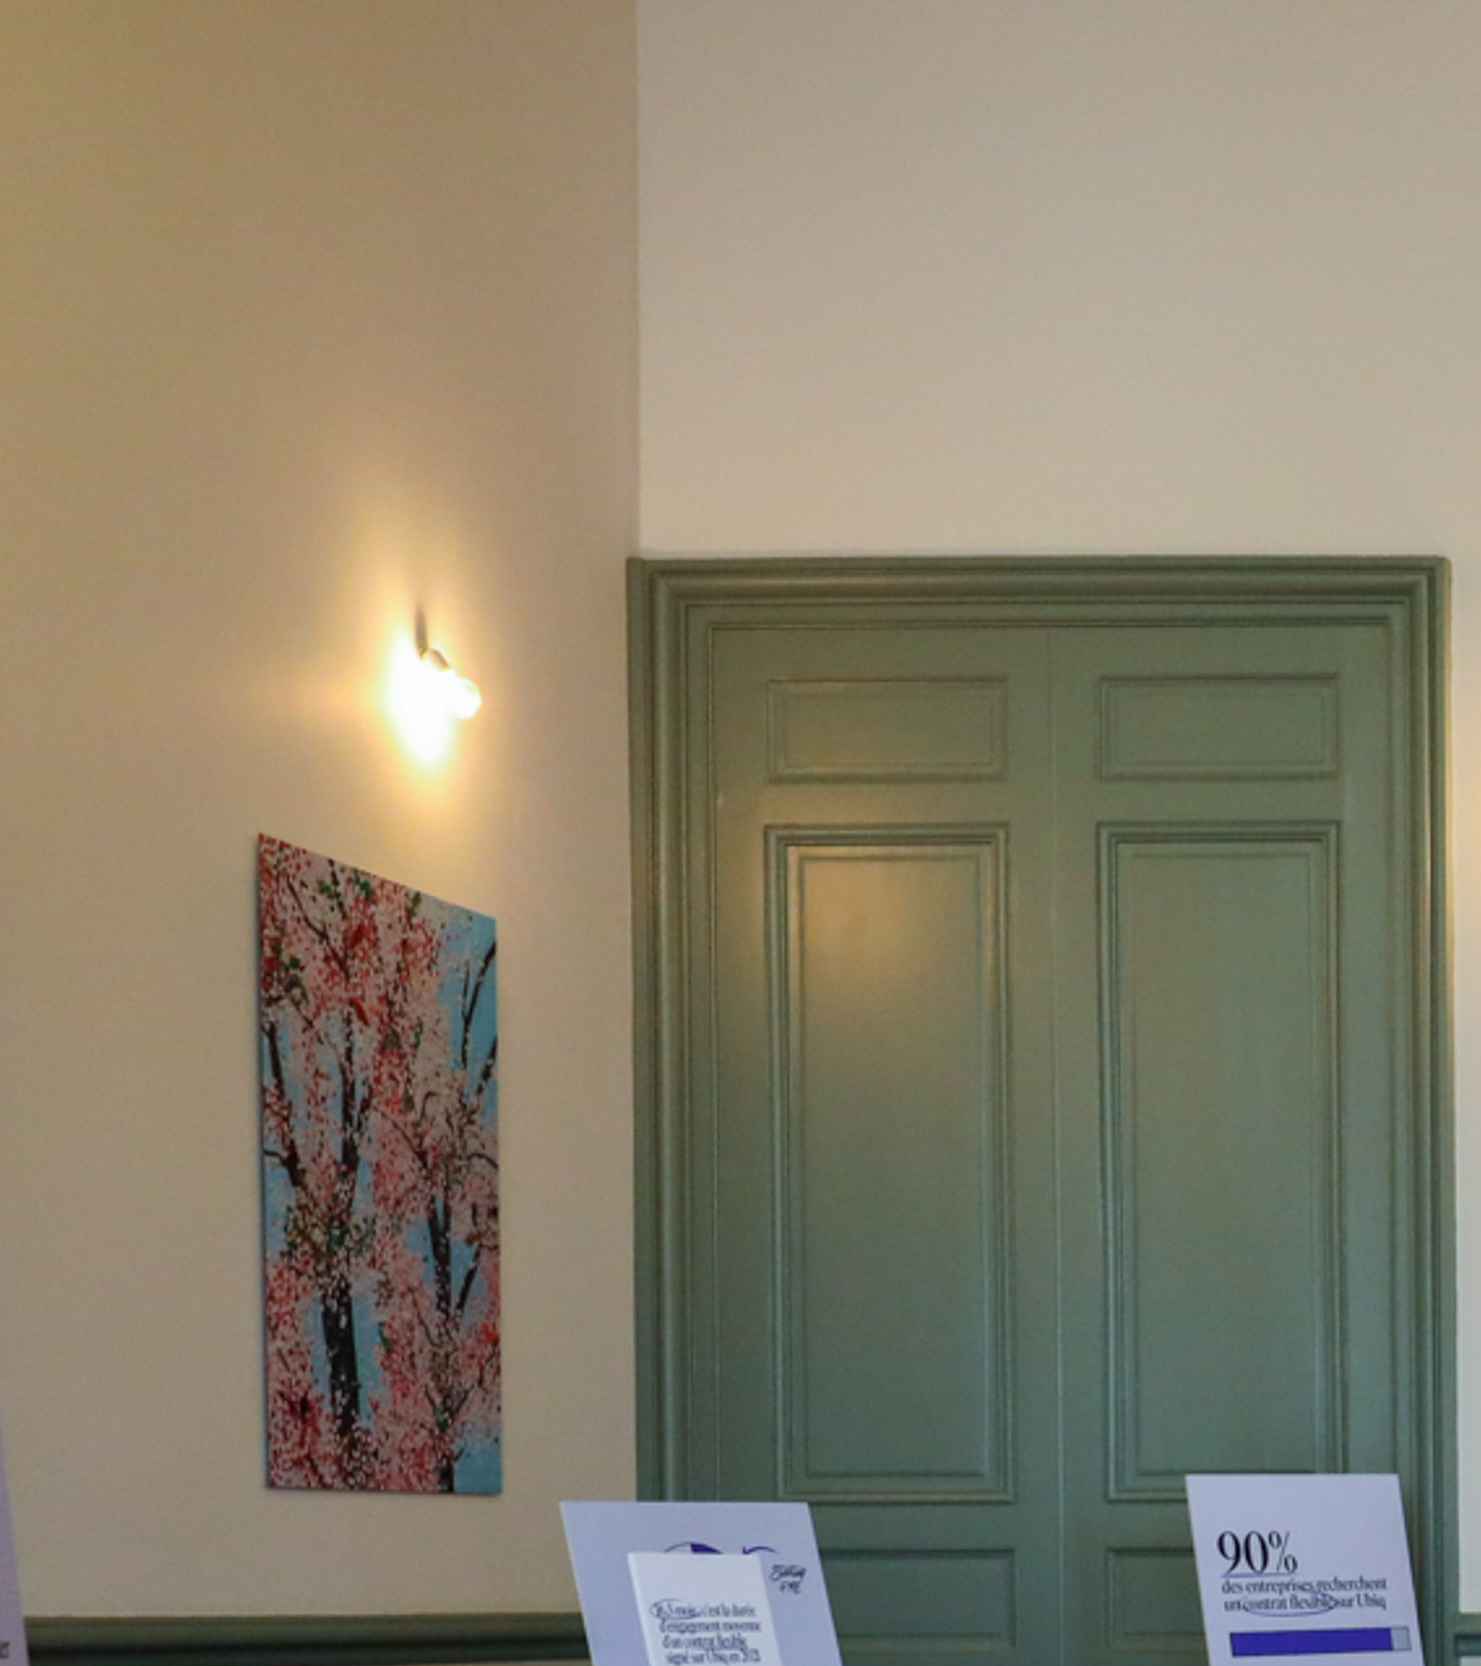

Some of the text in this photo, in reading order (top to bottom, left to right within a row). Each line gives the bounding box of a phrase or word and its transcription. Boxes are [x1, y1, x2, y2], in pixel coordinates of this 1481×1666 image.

[1217, 1530, 1298, 1575] 90%
[1221, 1575, 1388, 1595] des entreprises recherchent
[1224, 1600, 1241, 1612] un
[1242, 1597, 1287, 1612] contrat
[1335, 1597, 1354, 1608] sur
